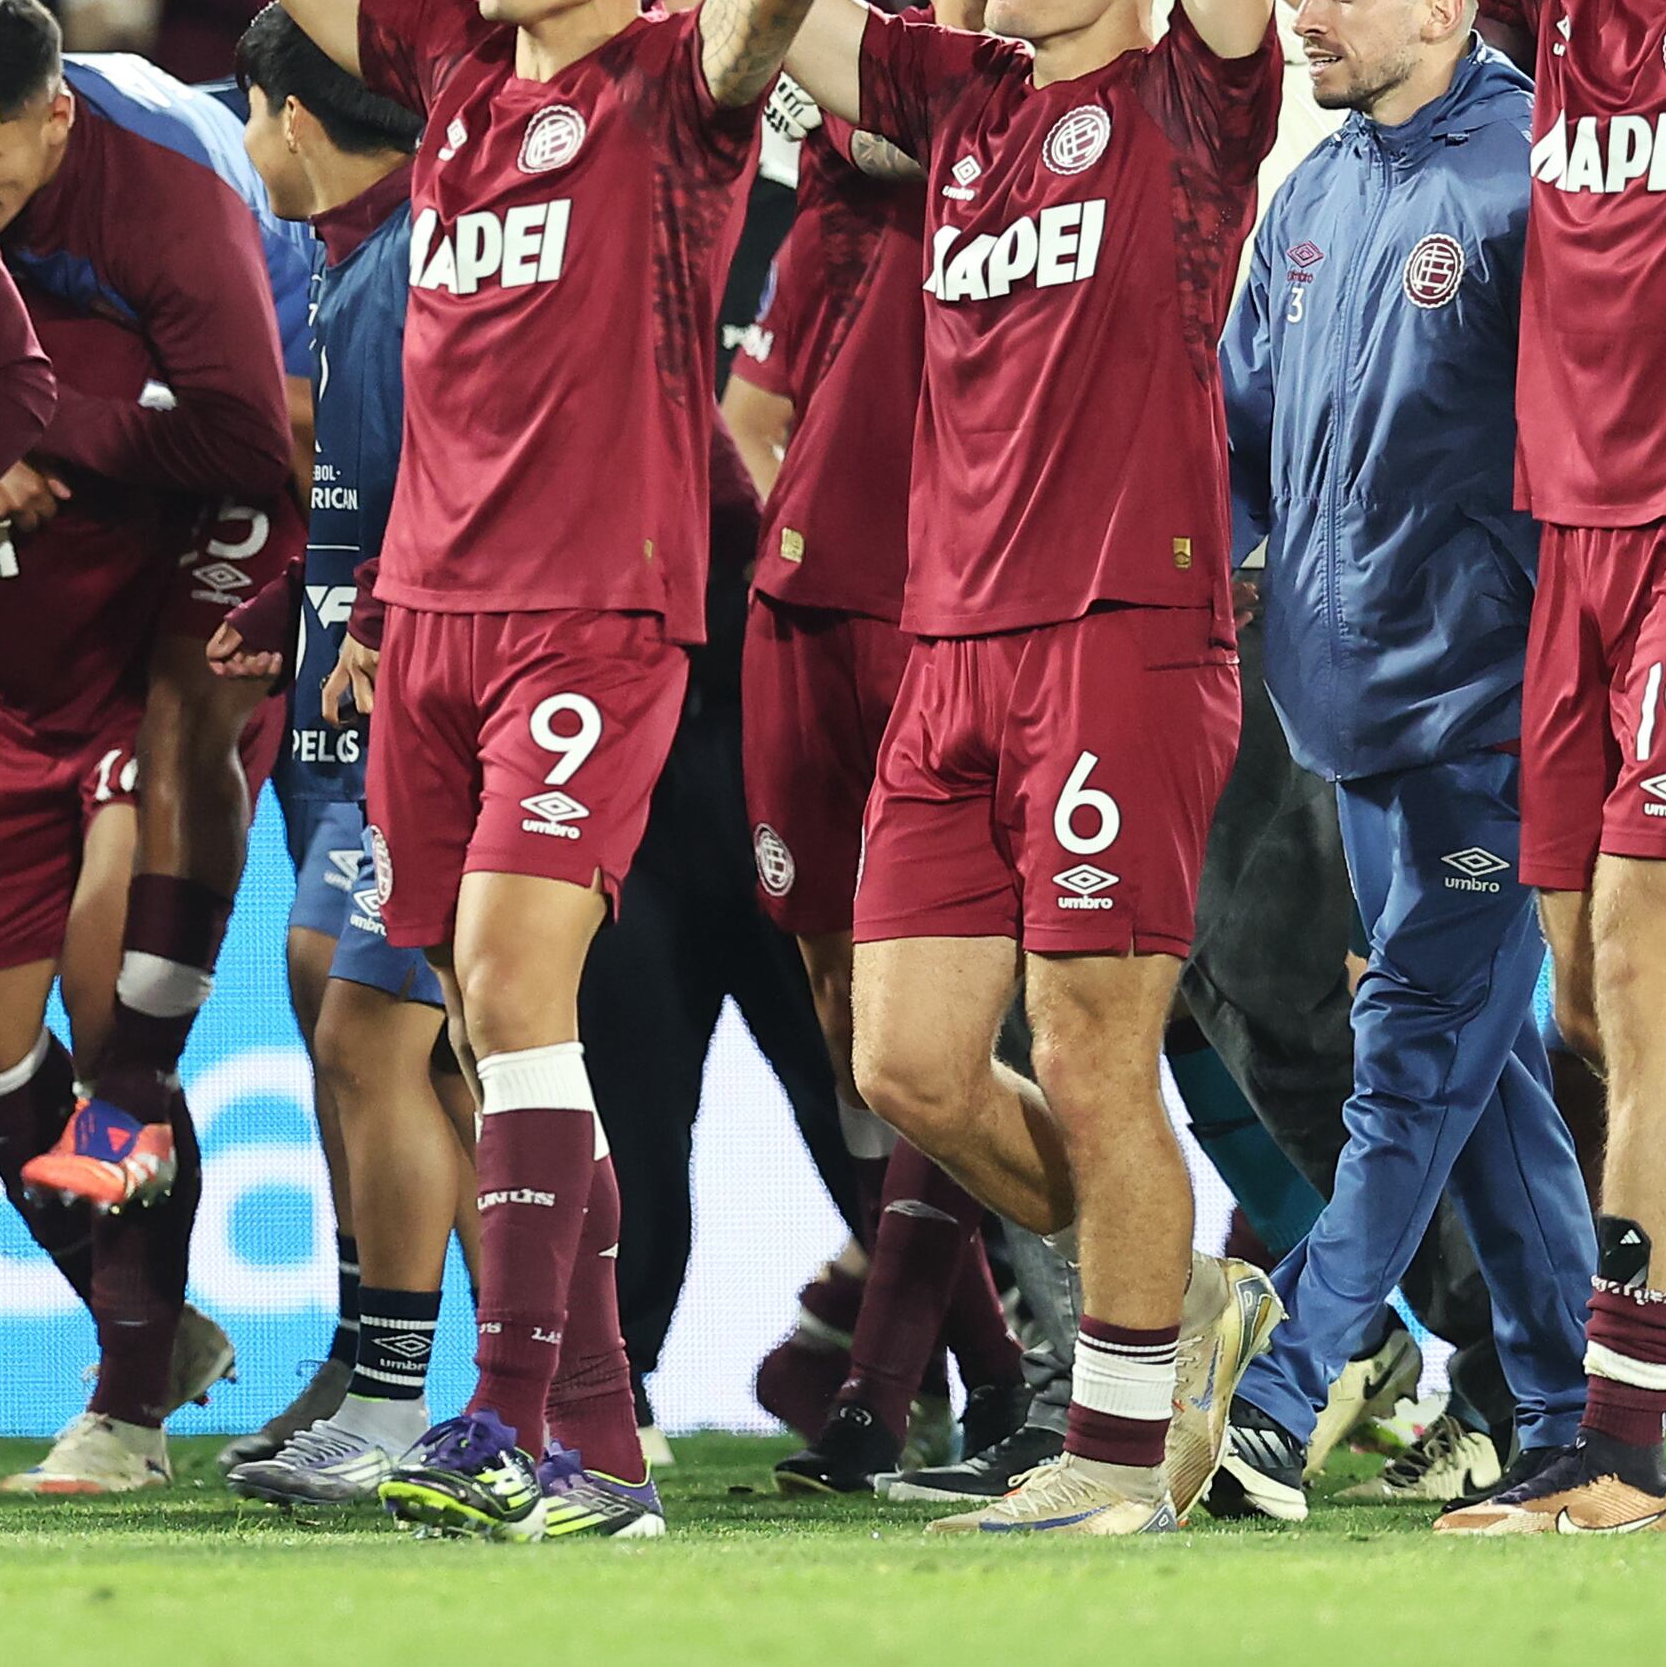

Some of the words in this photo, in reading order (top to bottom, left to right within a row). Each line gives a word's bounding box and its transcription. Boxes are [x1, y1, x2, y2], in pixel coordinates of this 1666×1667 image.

[1287, 287, 1304, 323] 3
[529, 692, 602, 786] 9
[1054, 750, 1121, 855] 6
[522, 819, 581, 840] umbro
[1444, 877, 1501, 893] umbro
[1058, 894, 1113, 910] umbro
[379, 1357, 428, 1371] umbr
